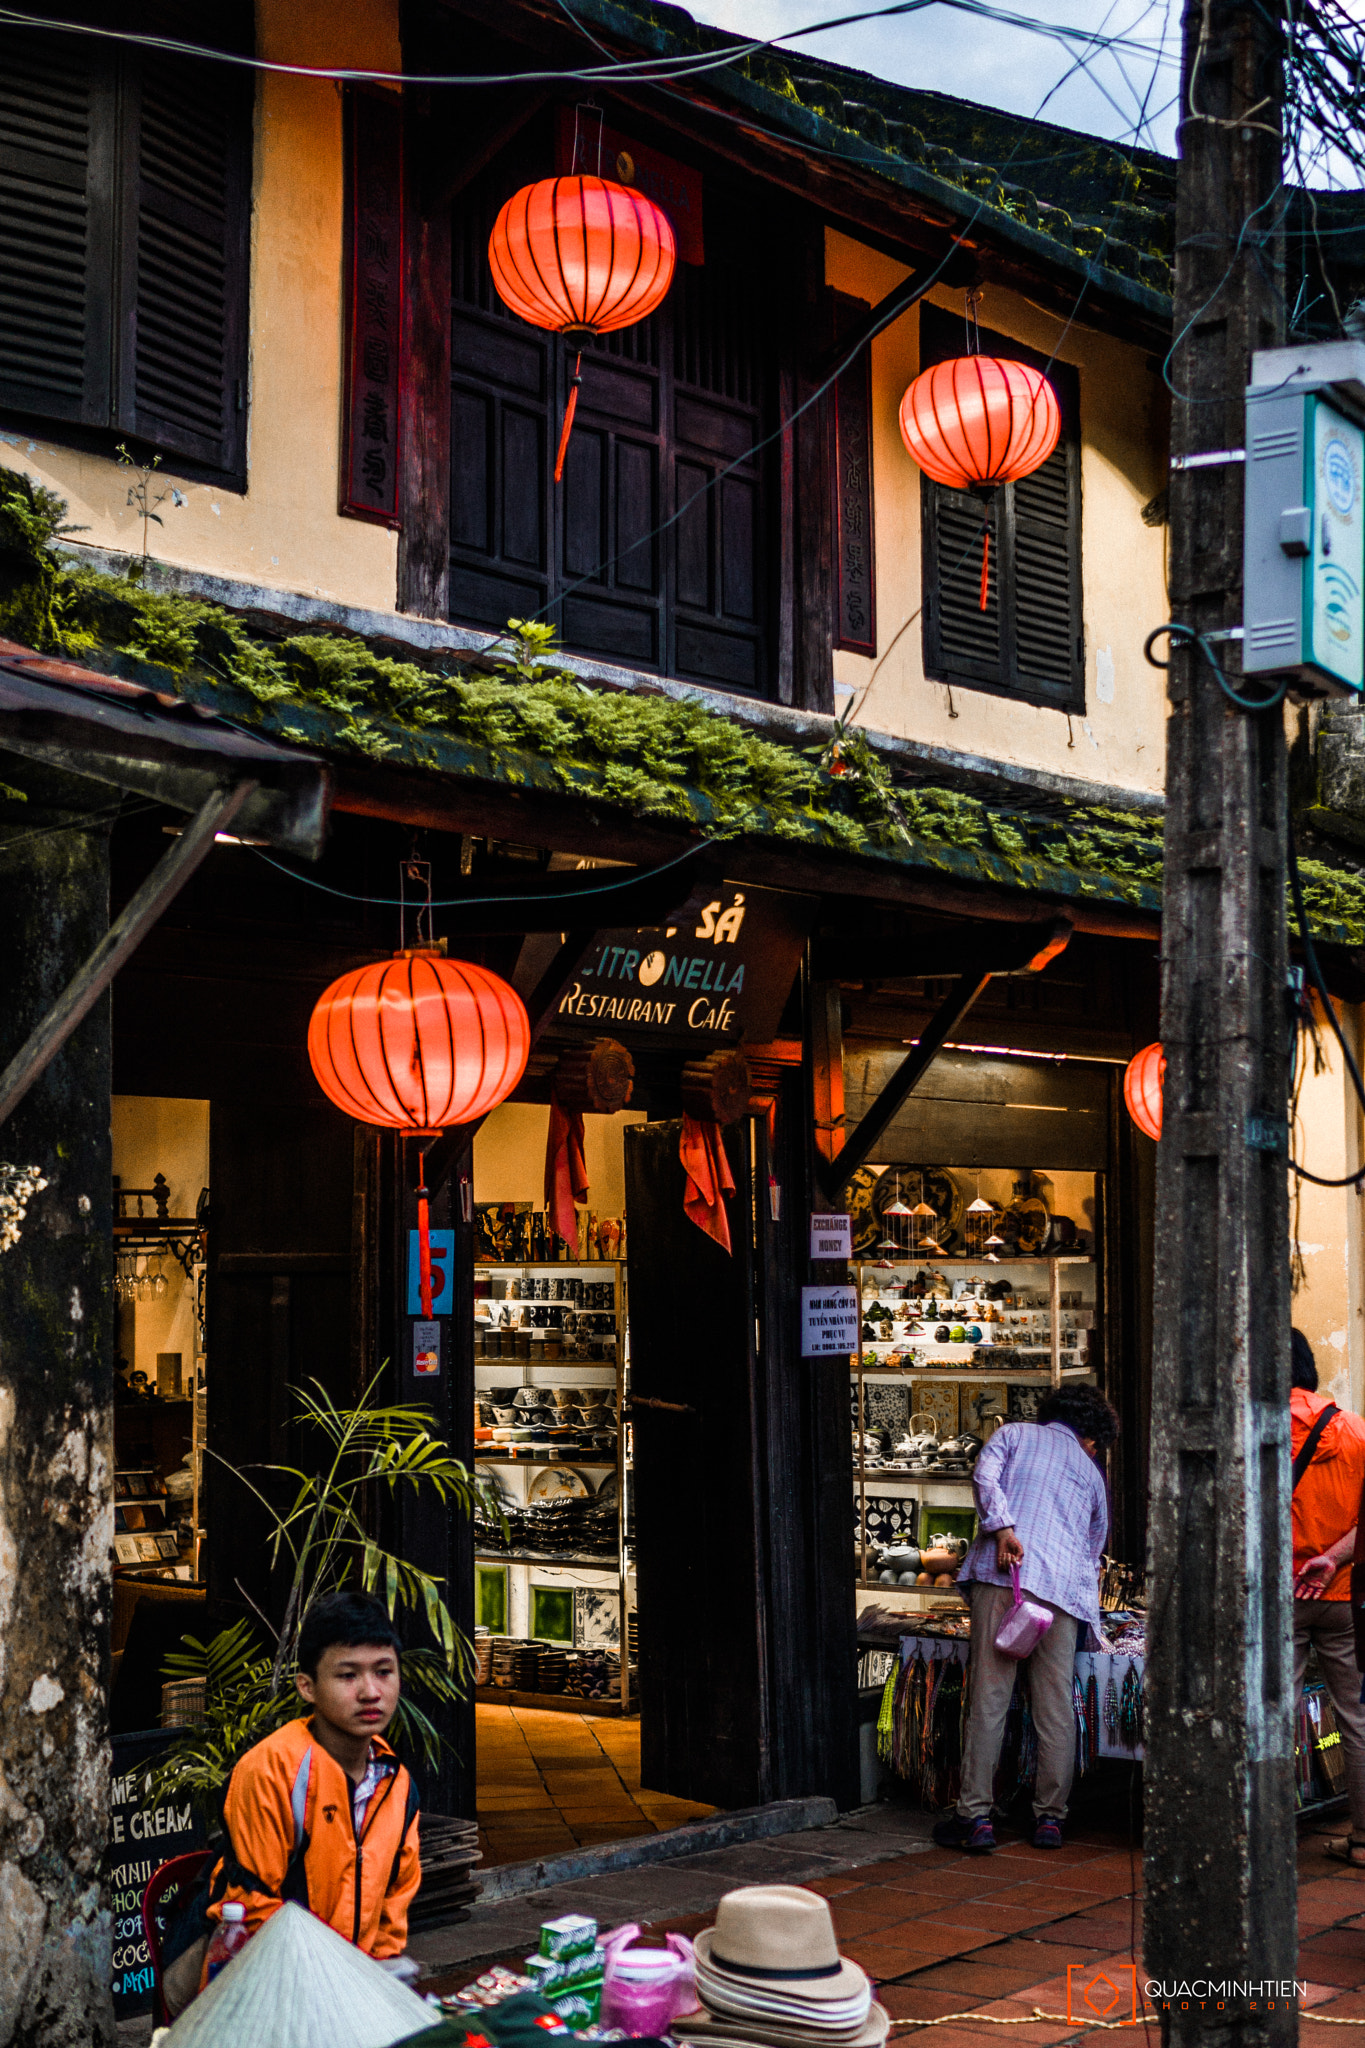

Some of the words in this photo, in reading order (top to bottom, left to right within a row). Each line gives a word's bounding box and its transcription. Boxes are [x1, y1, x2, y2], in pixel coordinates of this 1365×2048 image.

[695, 893, 746, 945] SẢ
[581, 945, 745, 995] ITRONELLA
[558, 982, 677, 1026] RESTAURANT
[819, 1239, 842, 1252] MONEY
[130, 1802, 193, 1840] CREAM
